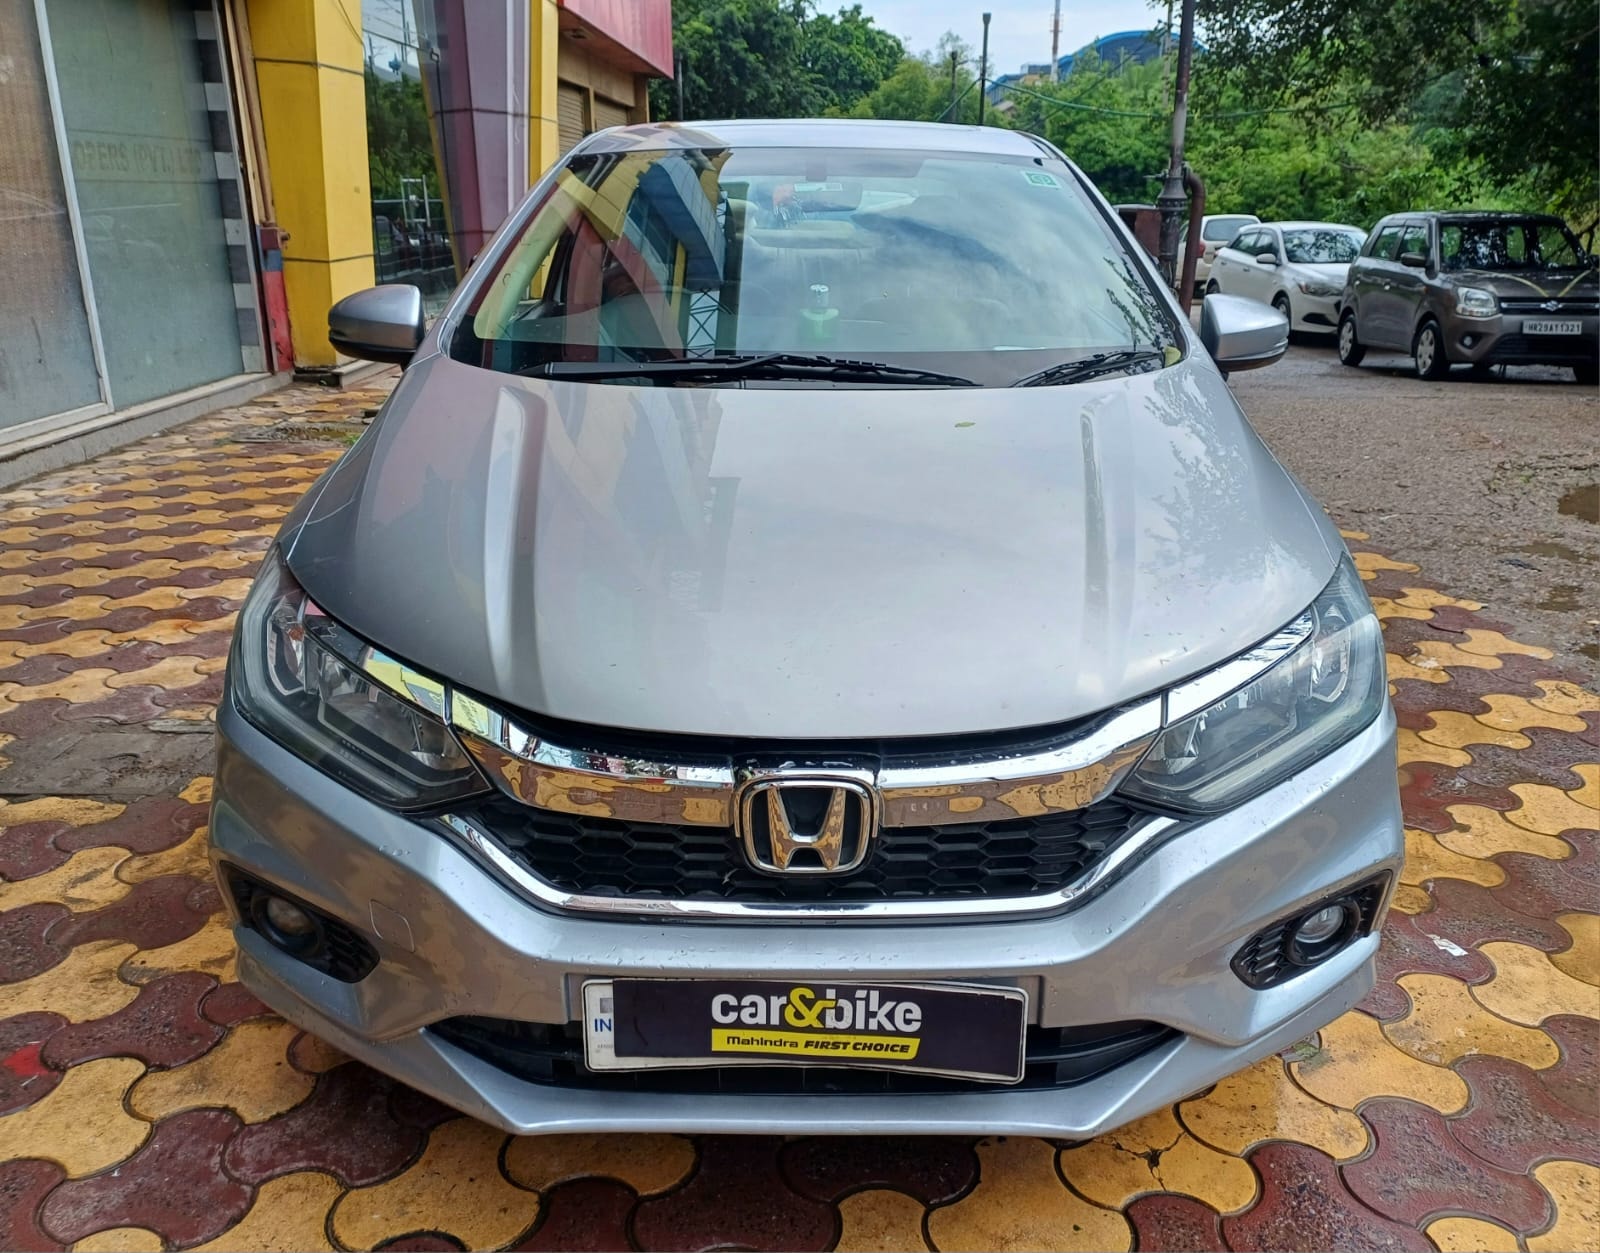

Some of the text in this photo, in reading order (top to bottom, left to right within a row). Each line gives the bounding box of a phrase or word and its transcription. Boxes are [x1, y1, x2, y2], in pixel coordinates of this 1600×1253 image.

[711, 987, 922, 1033] car&bike
[594, 1018, 612, 1032] IN
[726, 1035, 911, 1053] Mahindra FIRST CHOICE
